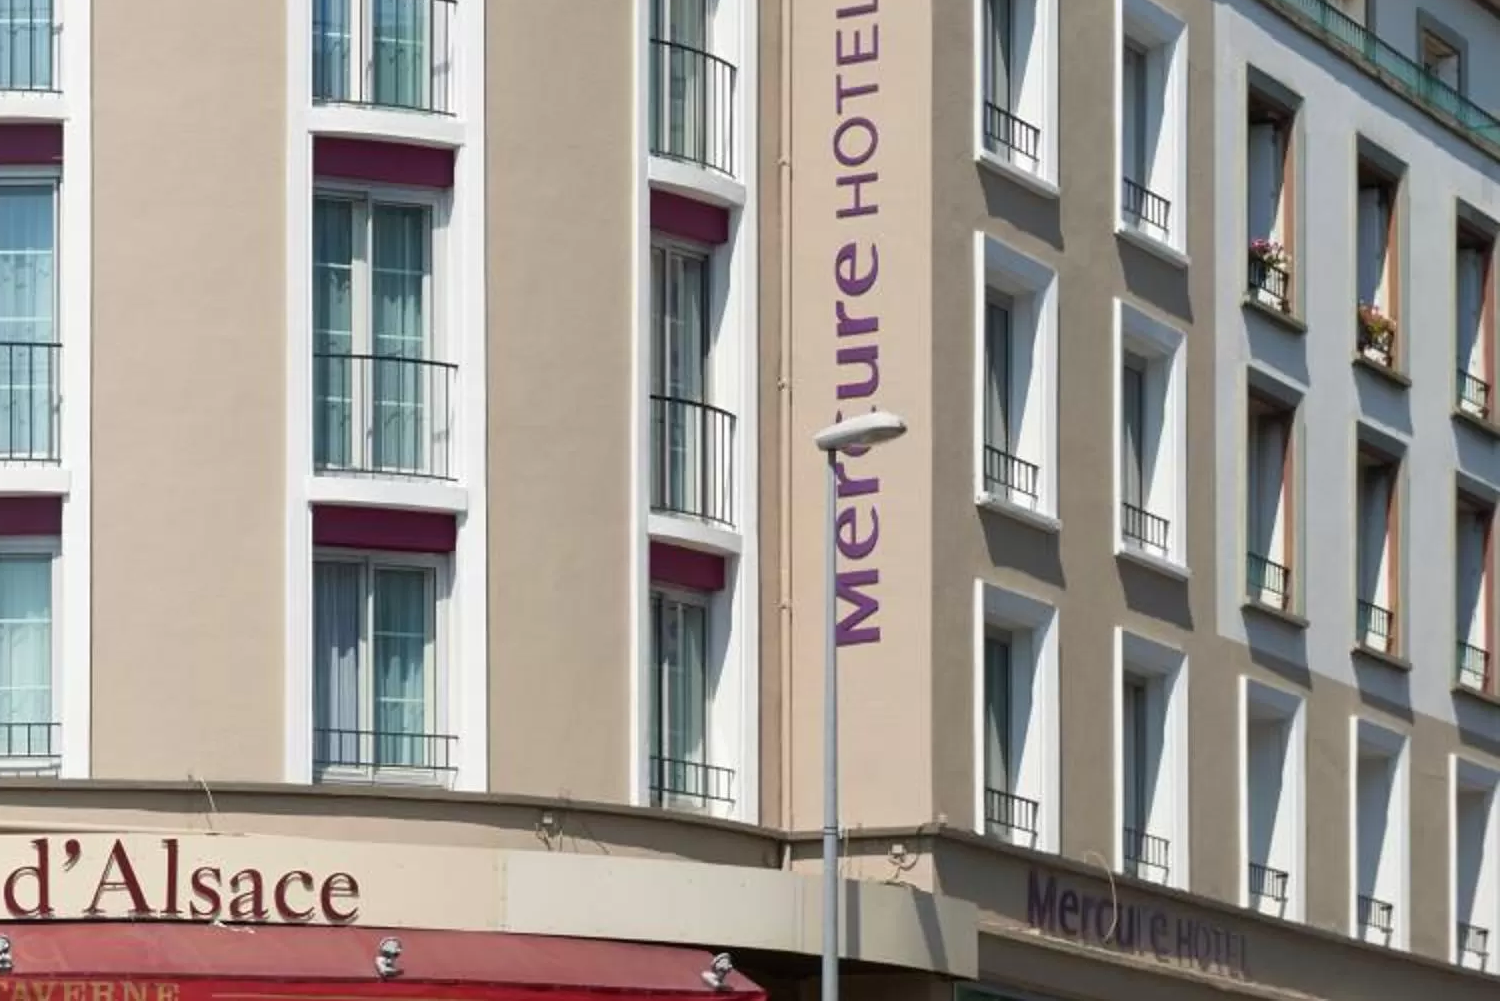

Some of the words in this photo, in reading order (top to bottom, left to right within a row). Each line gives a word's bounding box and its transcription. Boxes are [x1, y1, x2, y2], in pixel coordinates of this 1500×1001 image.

[3, 838, 360, 923] d'Alsace
[1027, 864, 1171, 962] Mercure
[1175, 916, 1251, 980] HOTEL
